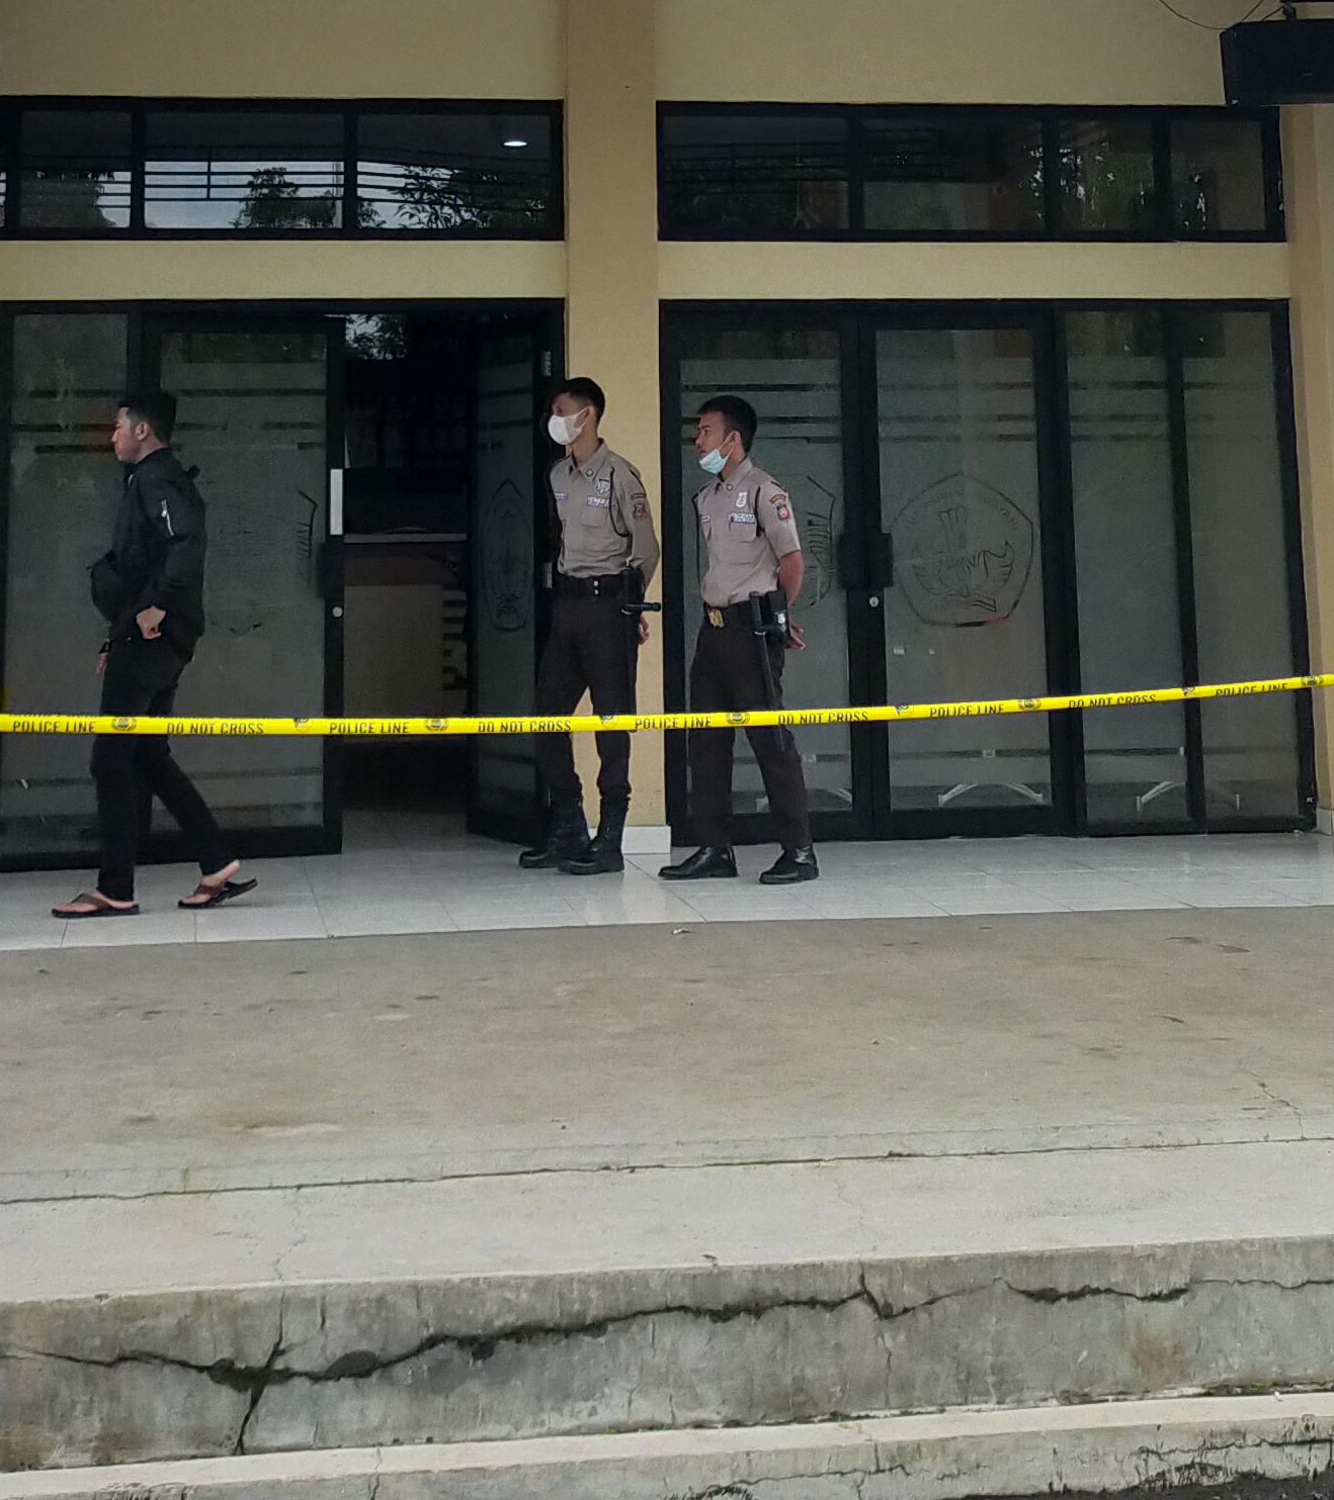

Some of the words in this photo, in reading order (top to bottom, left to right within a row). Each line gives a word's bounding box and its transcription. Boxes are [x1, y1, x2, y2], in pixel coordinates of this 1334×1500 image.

[929, 705, 973, 717] POLICE
[977, 704, 1005, 715] LINE
[635, 717, 679, 730] POLICE
[684, 717, 712, 729] LINE
[778, 714, 795, 726] DO
[799, 713, 823, 724] NOT
[828, 711, 869, 723] CROSS
[12, 721, 60, 733] POLICE
[65, 721, 96, 733] LINE
[166, 723, 184, 734] DO
[189, 723, 215, 735] NOT
[219, 723, 264, 735] CROSS
[329, 722, 376, 734] POLICE
[380, 721, 410, 734] LINE
[477, 721, 495, 733] DO
[500, 721, 525, 733] NOT
[529, 720, 572, 732] CROSS
